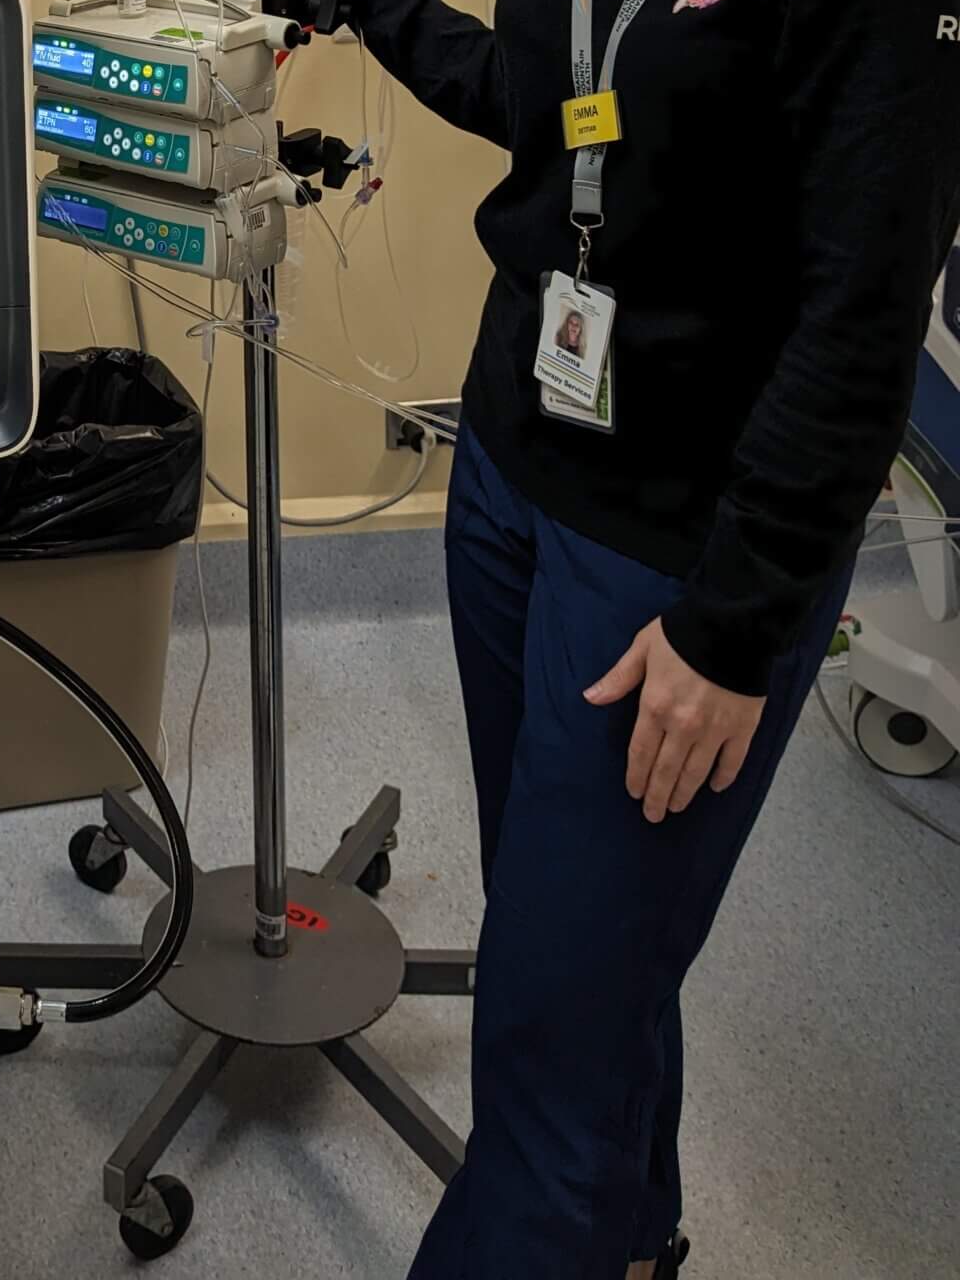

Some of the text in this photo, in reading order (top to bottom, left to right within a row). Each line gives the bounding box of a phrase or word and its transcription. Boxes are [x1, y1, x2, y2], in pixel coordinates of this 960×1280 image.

[936, 14, 960, 41] R
[44, 117, 56, 127] TPN
[573, 104, 599, 121] EMMA
[556, 349, 580, 369] Emma
[538, 365, 592, 400] Therapy Services
